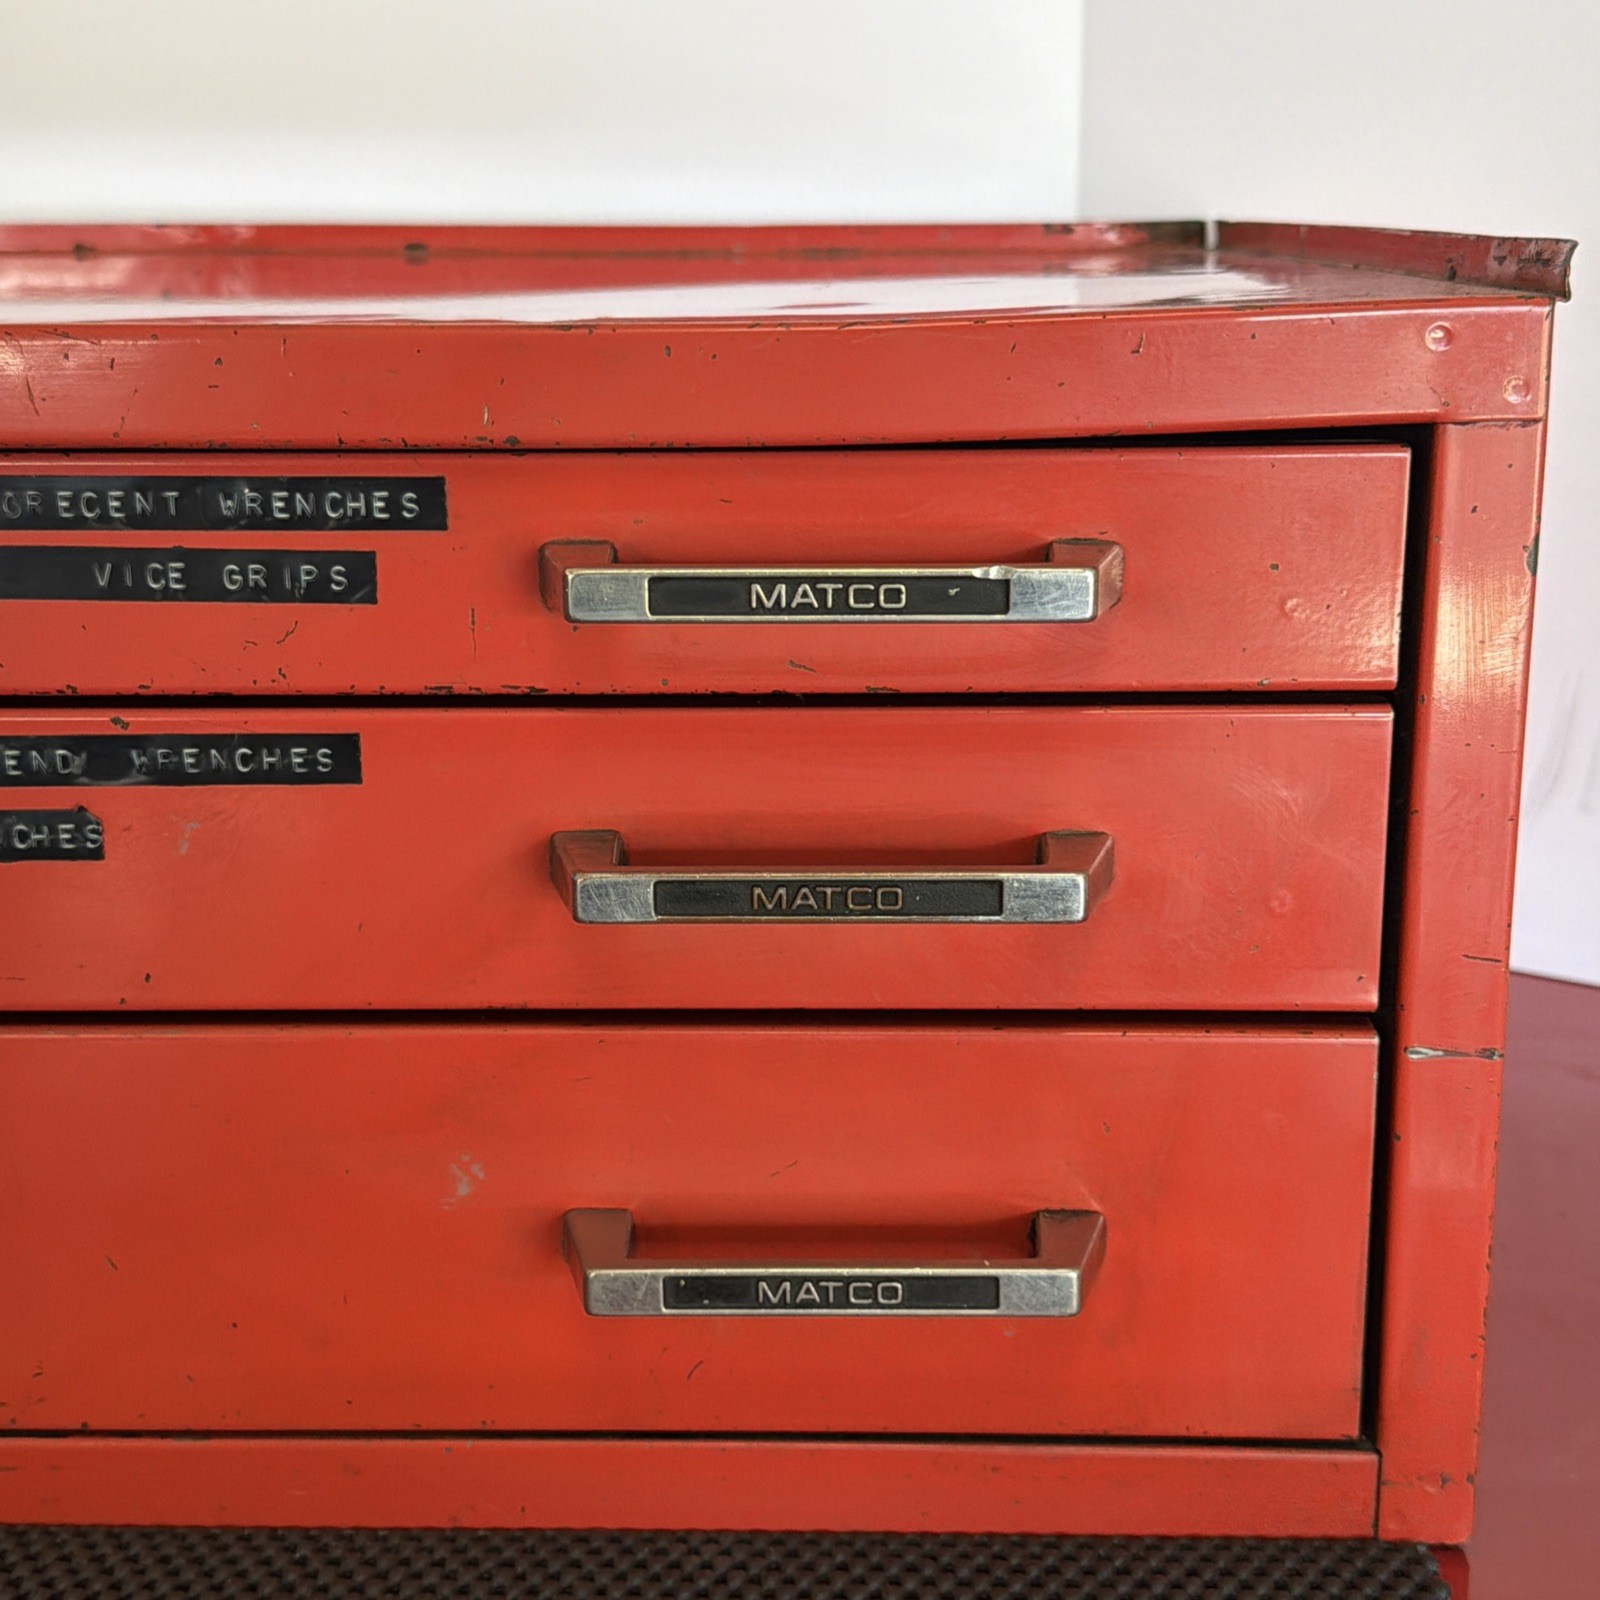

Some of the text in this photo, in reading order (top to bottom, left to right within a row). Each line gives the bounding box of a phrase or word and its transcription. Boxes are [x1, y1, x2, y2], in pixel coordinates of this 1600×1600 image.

[218, 490, 421, 520] WRENCHES
[93, 562, 349, 591] VICE GRIPS
[750, 583, 907, 609] MATCO
[752, 885, 904, 912] MATCO
[756, 1280, 904, 1305] MATCO
